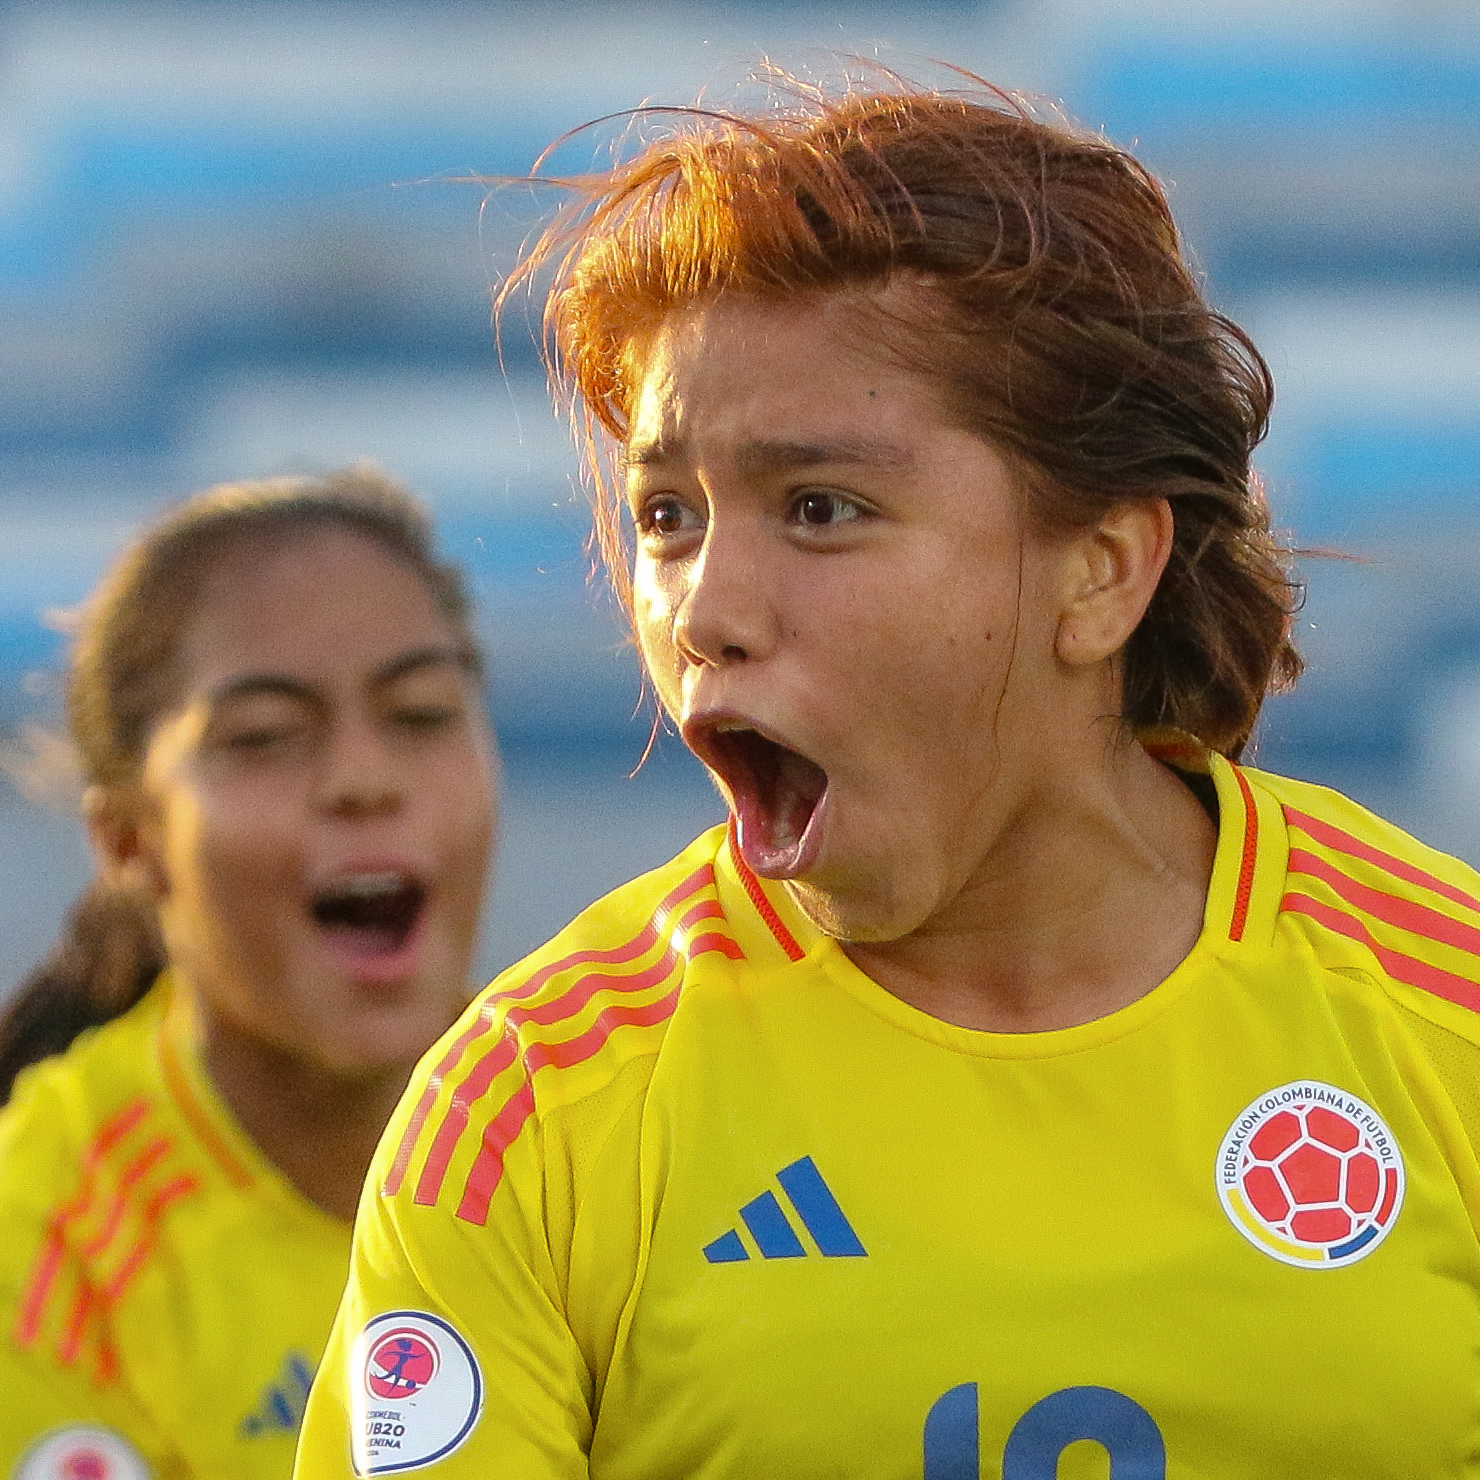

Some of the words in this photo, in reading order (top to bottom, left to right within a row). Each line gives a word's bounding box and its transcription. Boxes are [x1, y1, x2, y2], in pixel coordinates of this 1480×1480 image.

[1258, 1087, 1344, 1113] COLOMBIANA
[1345, 1102, 1363, 1119] DE
[365, 1422, 406, 1437] UB20
